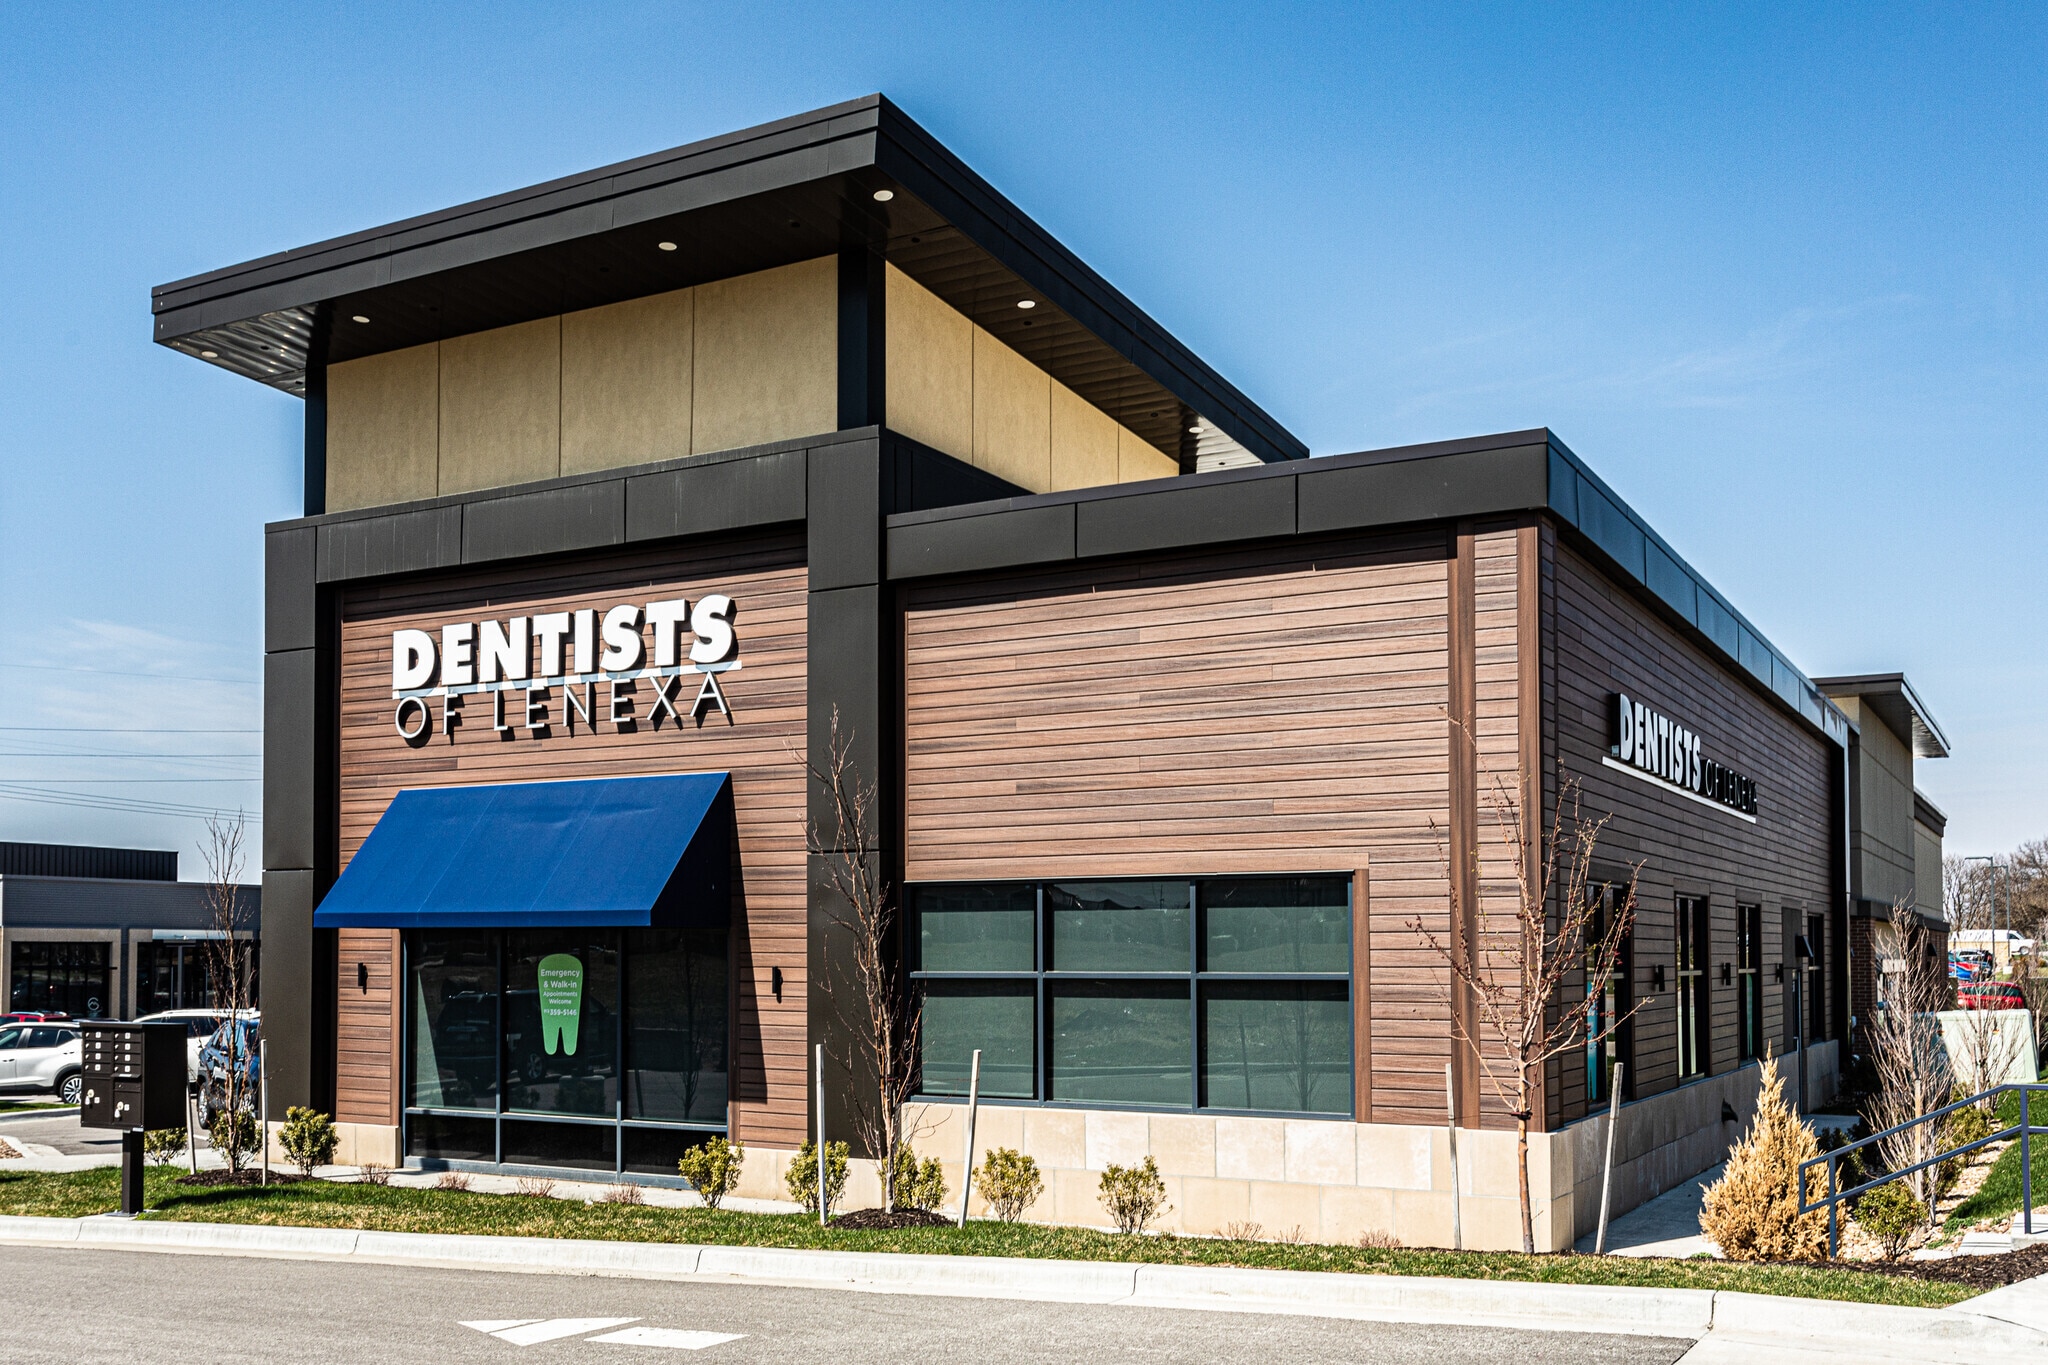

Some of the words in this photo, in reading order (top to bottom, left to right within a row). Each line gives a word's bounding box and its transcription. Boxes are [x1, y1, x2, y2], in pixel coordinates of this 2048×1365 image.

[392, 594, 735, 691] DENTISTS
[395, 691, 459, 739] OF
[493, 671, 729, 732] LENEXA
[1620, 692, 1701, 792] DENTISTS
[1705, 759, 1719, 798] OF
[540, 968, 580, 978] Emergency
[543, 980, 549, 988] &
[550, 980, 577, 988] Walk-in
